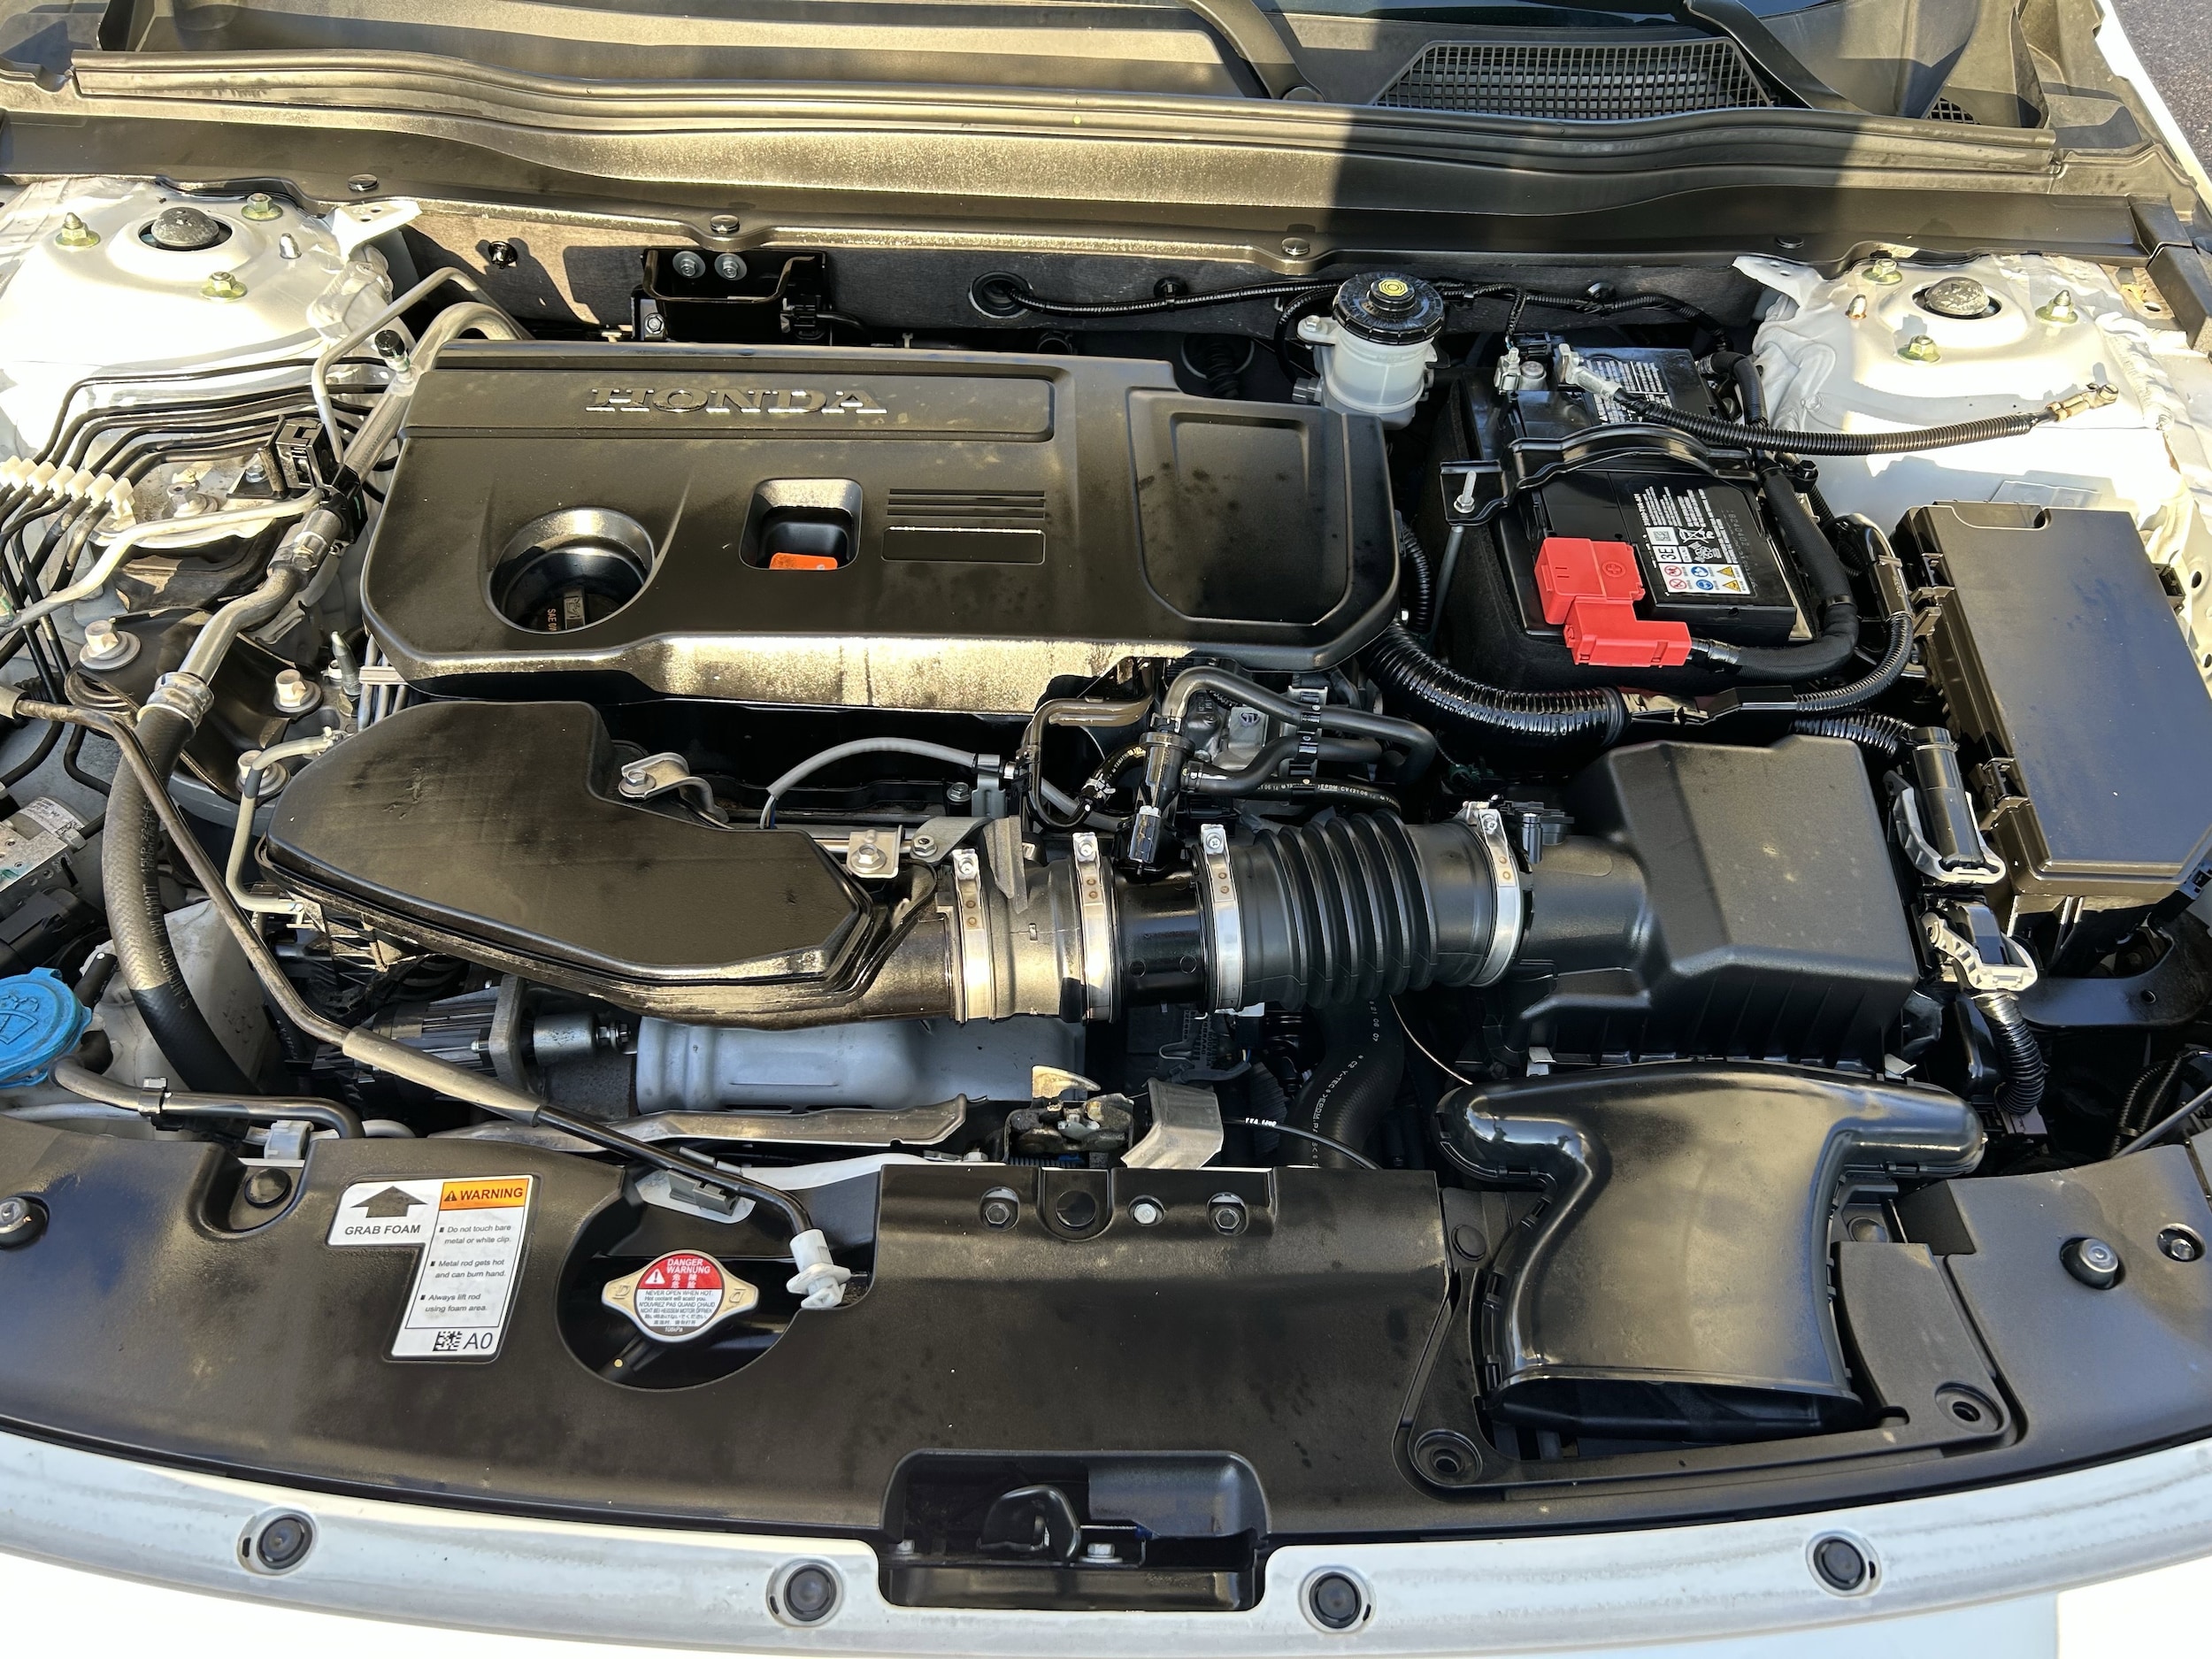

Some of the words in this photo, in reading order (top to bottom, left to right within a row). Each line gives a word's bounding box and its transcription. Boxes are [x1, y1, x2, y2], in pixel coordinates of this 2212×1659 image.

[585, 387, 887, 414] HONDA
[1658, 548, 1677, 560] 3E
[547, 608, 557, 622] SAE
[460, 1187, 523, 1201] WARNING
[344, 1225, 380, 1235] GRAB
[384, 1225, 421, 1234] FOAM
[666, 1265, 711, 1274] WARNUNG
[463, 1332, 493, 1350] A0
